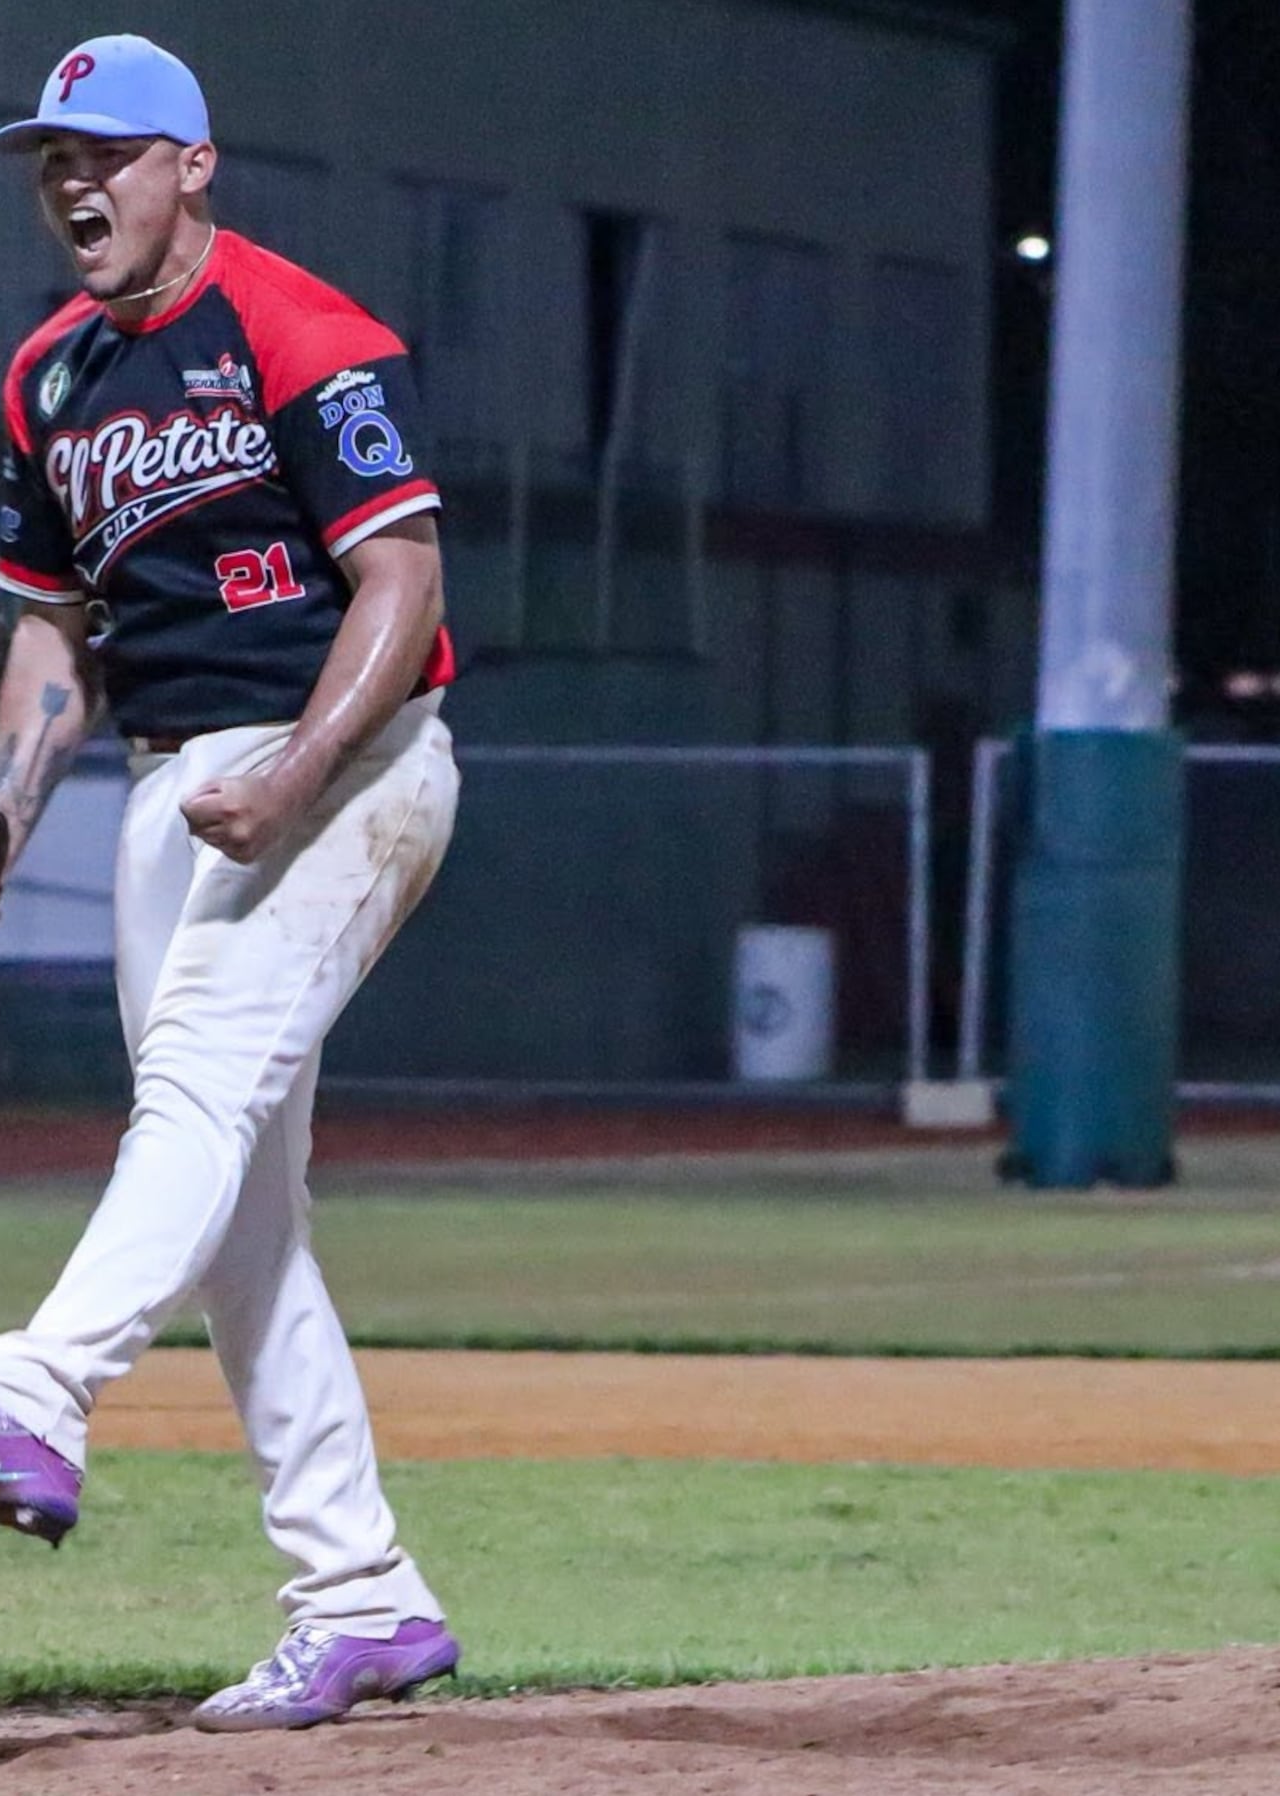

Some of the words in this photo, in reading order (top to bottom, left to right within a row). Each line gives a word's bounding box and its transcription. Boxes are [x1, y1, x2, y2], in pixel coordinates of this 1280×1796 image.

[59, 53, 95, 103] P
[318, 384, 385, 430] DON
[46, 435, 92, 522] El
[91, 409, 273, 508] Petate
[338, 409, 413, 477] Q
[102, 502, 148, 548] CITY
[215, 541, 306, 613] 21
